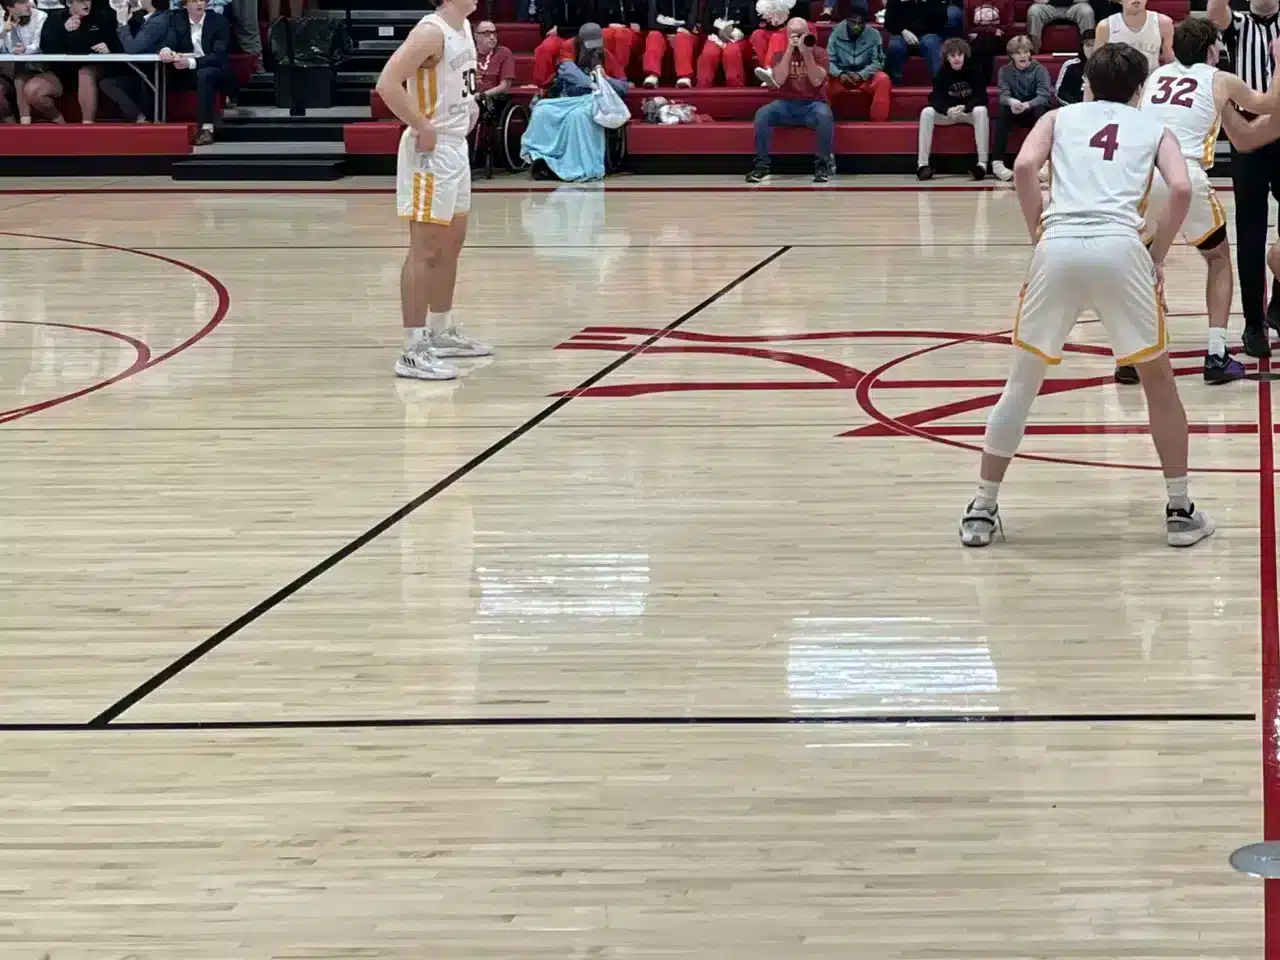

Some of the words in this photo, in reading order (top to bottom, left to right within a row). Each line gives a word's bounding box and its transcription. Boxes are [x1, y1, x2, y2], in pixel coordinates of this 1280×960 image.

[462, 68, 476, 98] 30
[1151, 76, 1198, 108] 32
[1089, 123, 1119, 161] 4
